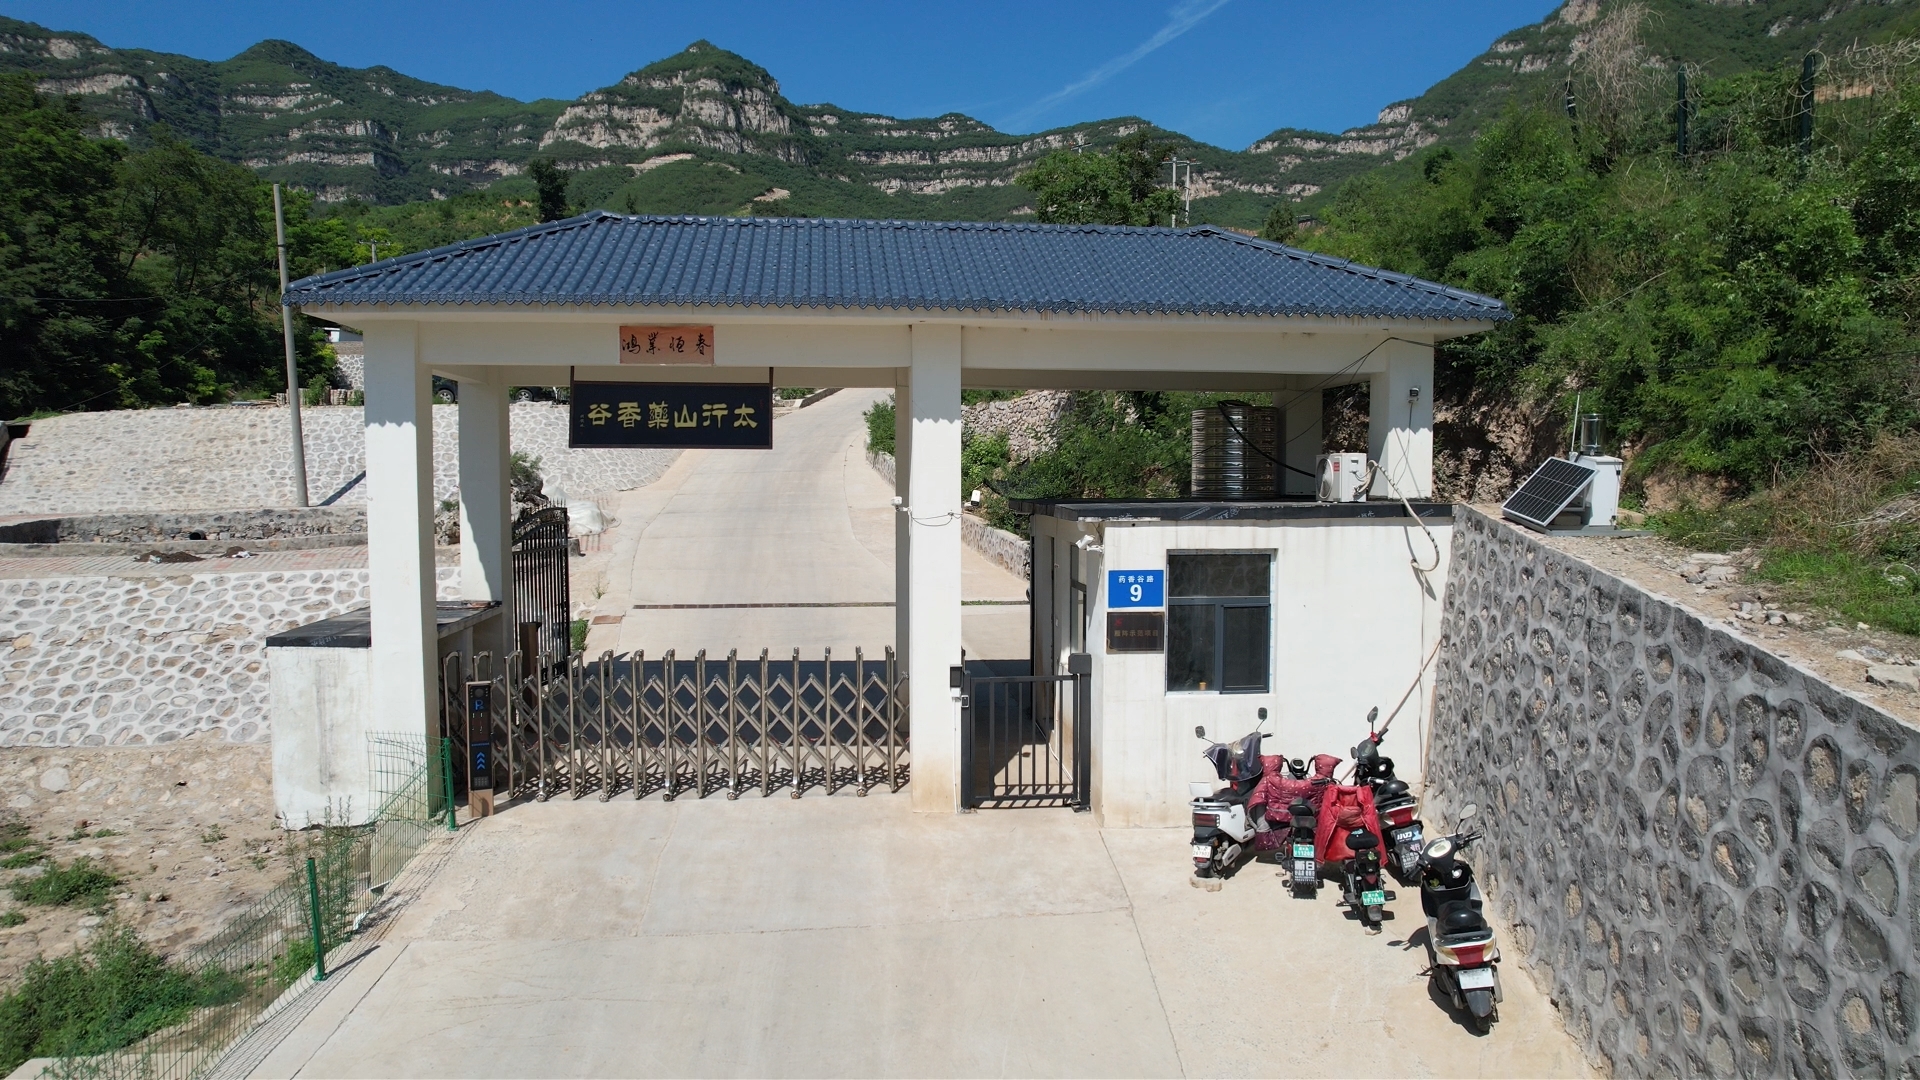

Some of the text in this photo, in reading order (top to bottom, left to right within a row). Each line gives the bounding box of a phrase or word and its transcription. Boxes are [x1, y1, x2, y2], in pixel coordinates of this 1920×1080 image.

[1118, 575, 1154, 584] 药香谷路
[1130, 584, 1142, 602] 9
